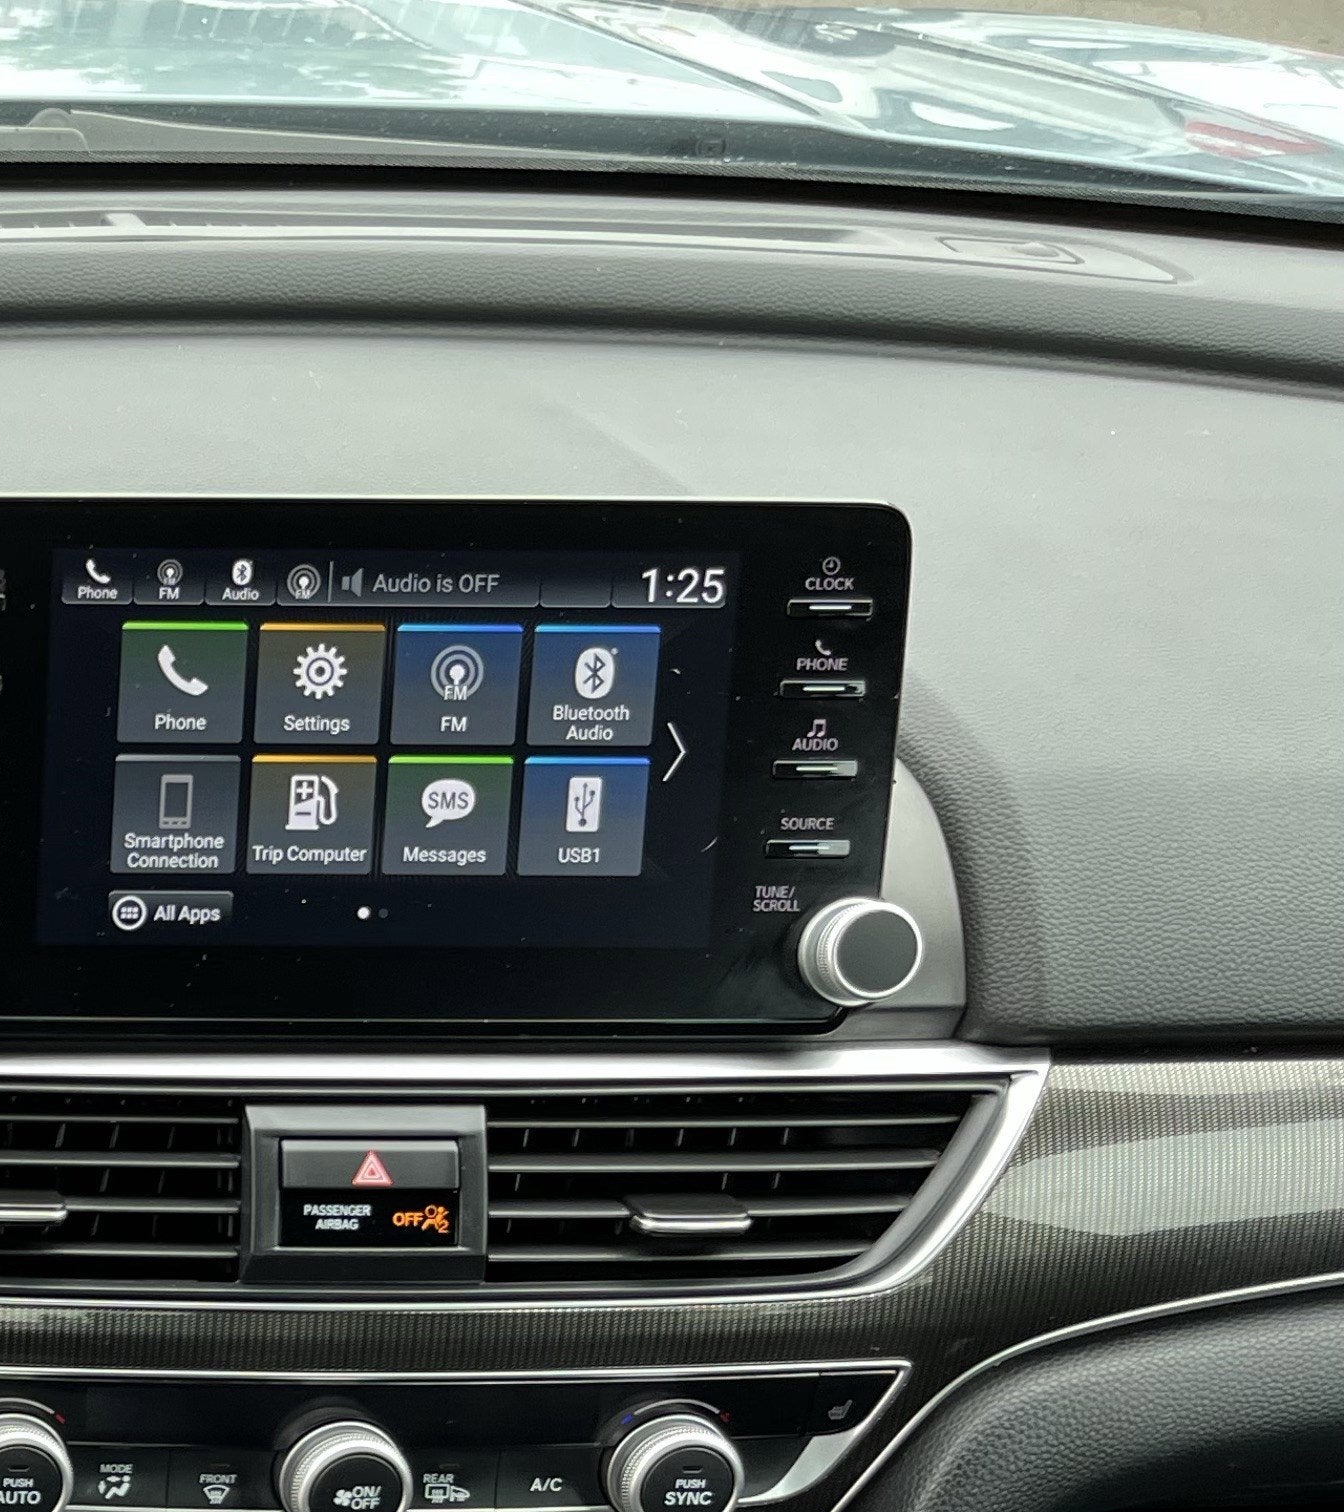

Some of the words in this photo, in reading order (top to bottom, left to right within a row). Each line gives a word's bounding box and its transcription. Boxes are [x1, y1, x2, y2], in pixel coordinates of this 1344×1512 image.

[372, 573, 431, 593] Audio
[436, 574, 453, 593] is
[458, 574, 500, 593] OFF
[642, 567, 725, 604] 1:25
[805, 578, 854, 591] CLOCK
[77, 586, 118, 600] Phone
[159, 587, 180, 600] FM
[222, 587, 259, 601] Audio
[796, 657, 849, 671] PHONE
[444, 686, 467, 701] FM
[553, 705, 630, 722] Bluetooth
[155, 714, 207, 731] Phone
[284, 715, 350, 735] Settings
[441, 717, 467, 732] FM
[566, 725, 613, 741] Audio
[792, 738, 839, 751] AUDIO
[427, 792, 469, 810] SMS
[781, 817, 835, 831] SOURCE
[124, 833, 225, 853] Smartphone
[126, 853, 219, 869] Connection
[252, 845, 283, 864] Trip
[287, 845, 368, 864] Computer
[403, 846, 487, 866] Messages
[558, 847, 600, 863] USB1
[755, 885, 796, 899] TUNE/
[753, 899, 800, 913] SCROLL
[154, 905, 177, 921] All
[179, 905, 220, 924] Apps
[303, 1203, 372, 1217] PASSENGER
[315, 1218, 360, 1231] AIRBAG
[392, 1211, 424, 1228] OFF
[99, 1463, 133, 1475] MODE
[3, 1477, 34, 1489] PUSH
[199, 1473, 237, 1485] FRONT
[423, 1472, 454, 1484] REAR
[530, 1477, 563, 1493] A/C
[675, 1478, 706, 1490] PUSH
[353, 1485, 382, 1500] ON/
[664, 1491, 712, 1507] SYNC
[351, 1497, 380, 1511] OFF
